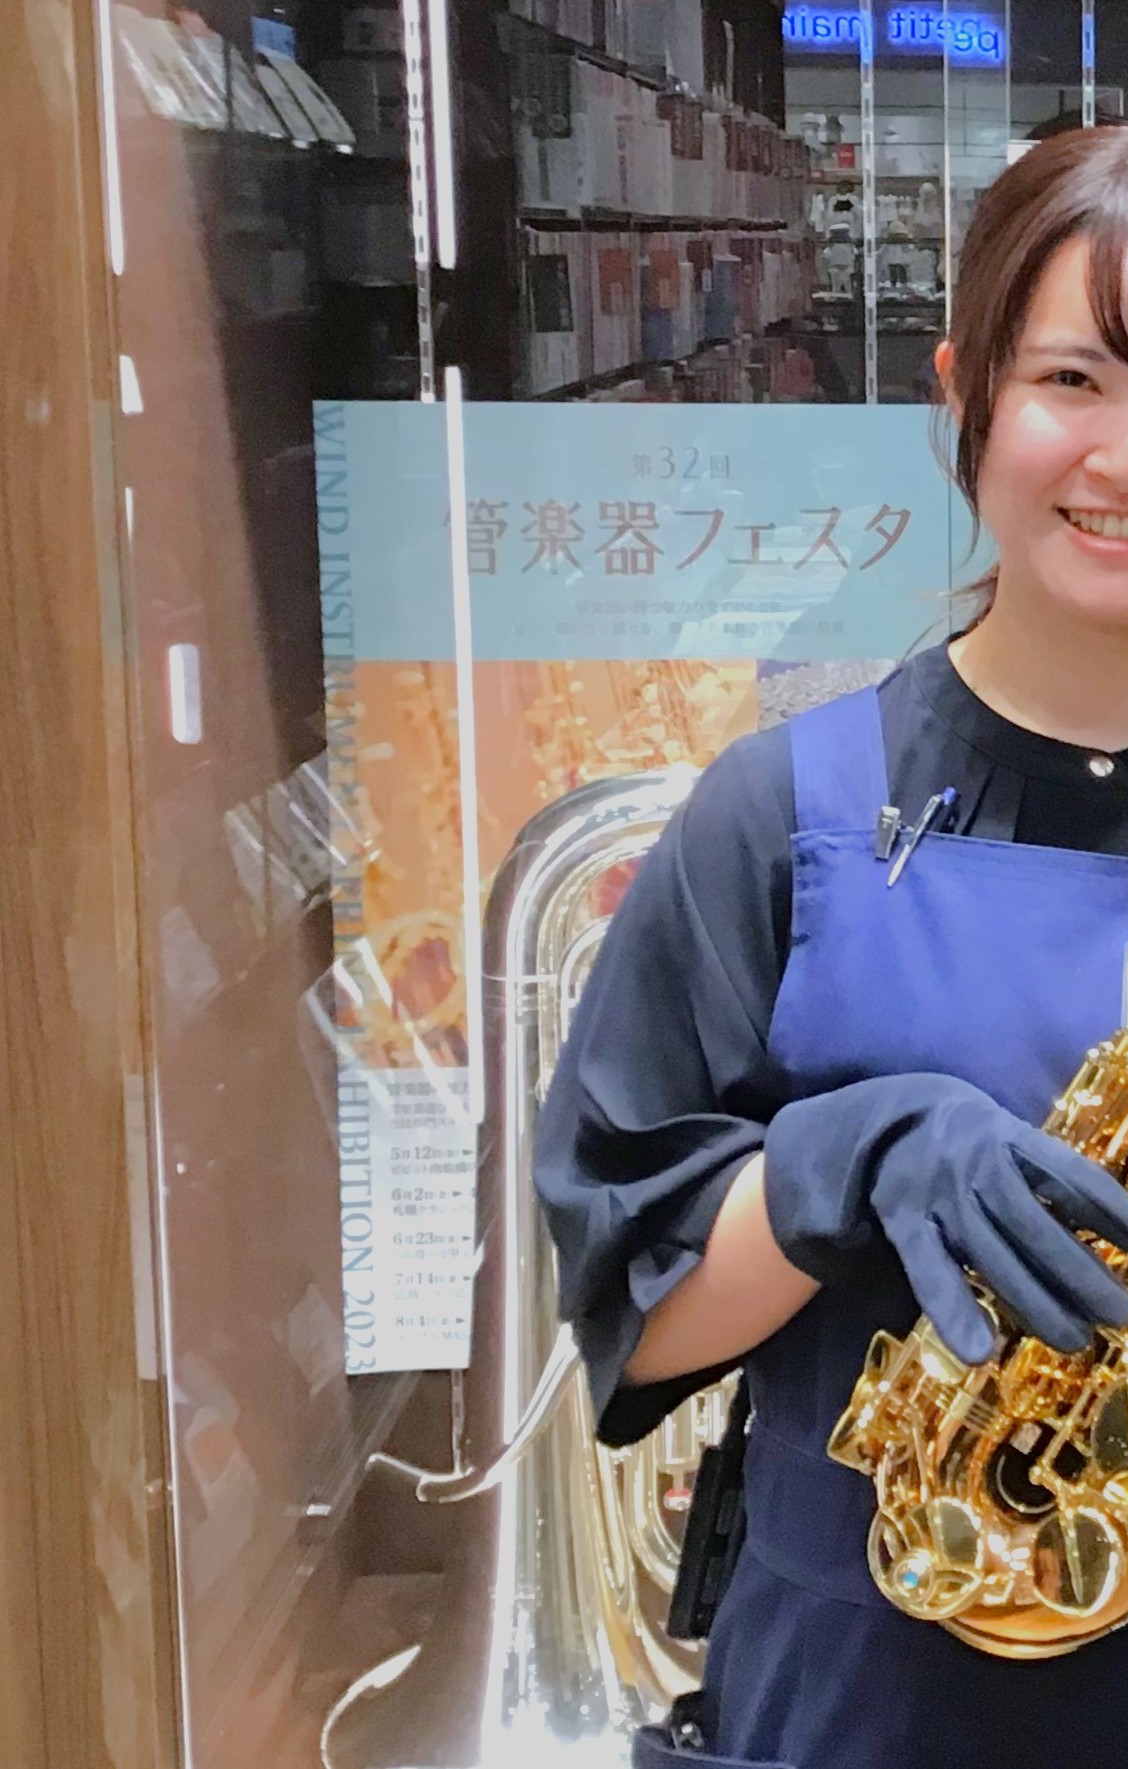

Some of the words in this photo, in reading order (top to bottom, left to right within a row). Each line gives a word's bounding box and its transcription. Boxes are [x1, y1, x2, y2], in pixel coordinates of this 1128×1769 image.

[631, 446, 731, 481] 第32回
[443, 498, 912, 577] 管楽器フェスタ
[313, 403, 350, 536] WIND
[343, 1289, 377, 1374] 2023
